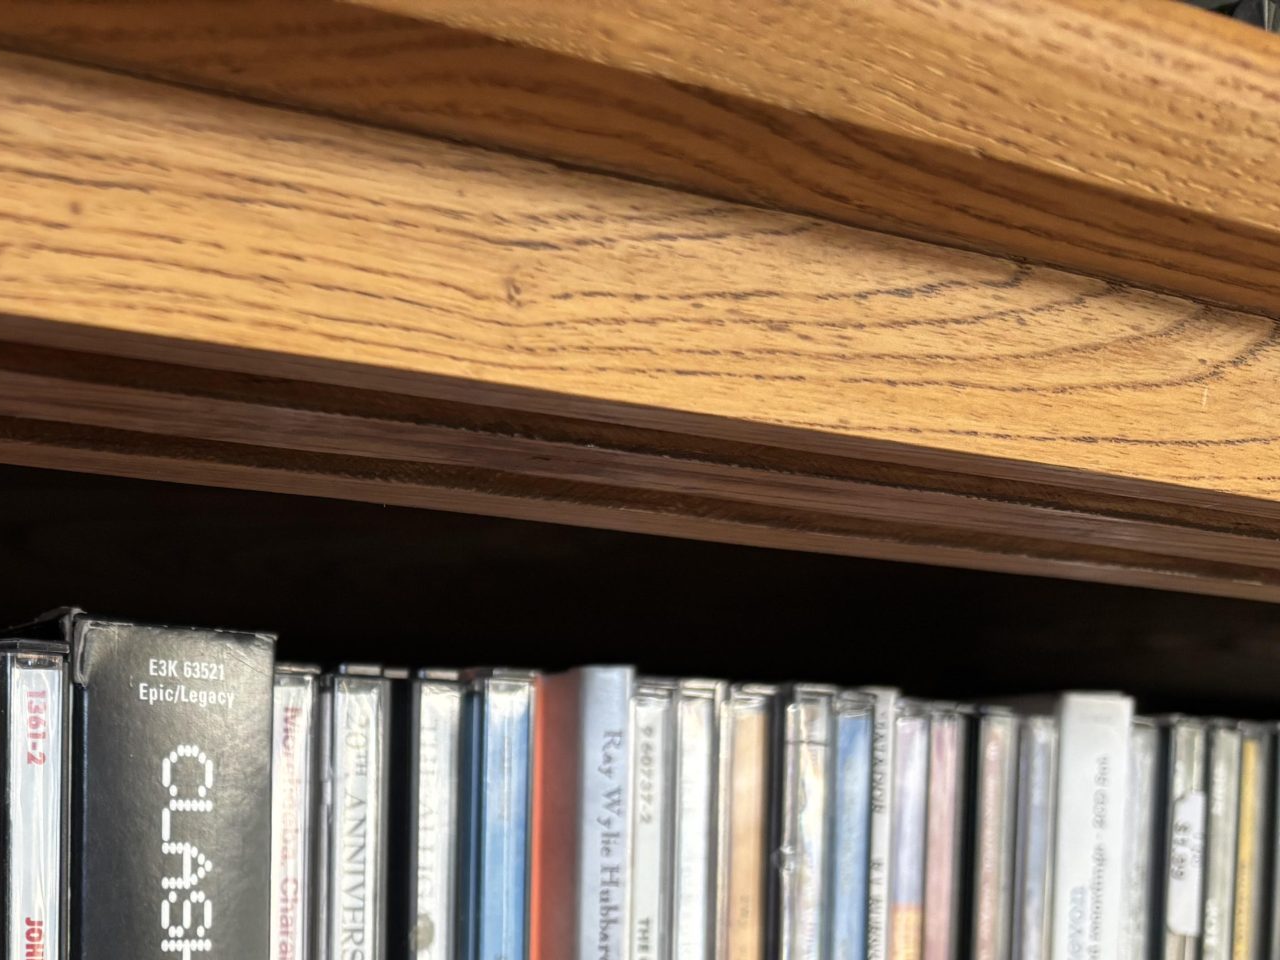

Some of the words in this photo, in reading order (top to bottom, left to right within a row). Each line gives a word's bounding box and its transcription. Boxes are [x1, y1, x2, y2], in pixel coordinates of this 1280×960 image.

[149, 658, 181, 676] E3K
[183, 664, 226, 682] 63521
[138, 681, 236, 710] Epic/Legacy
[26, 689, 47, 766] 1361-2
[598, 729, 623, 778] Ray
[596, 785, 623, 858] Wylie
[637, 917, 651, 953] THE
